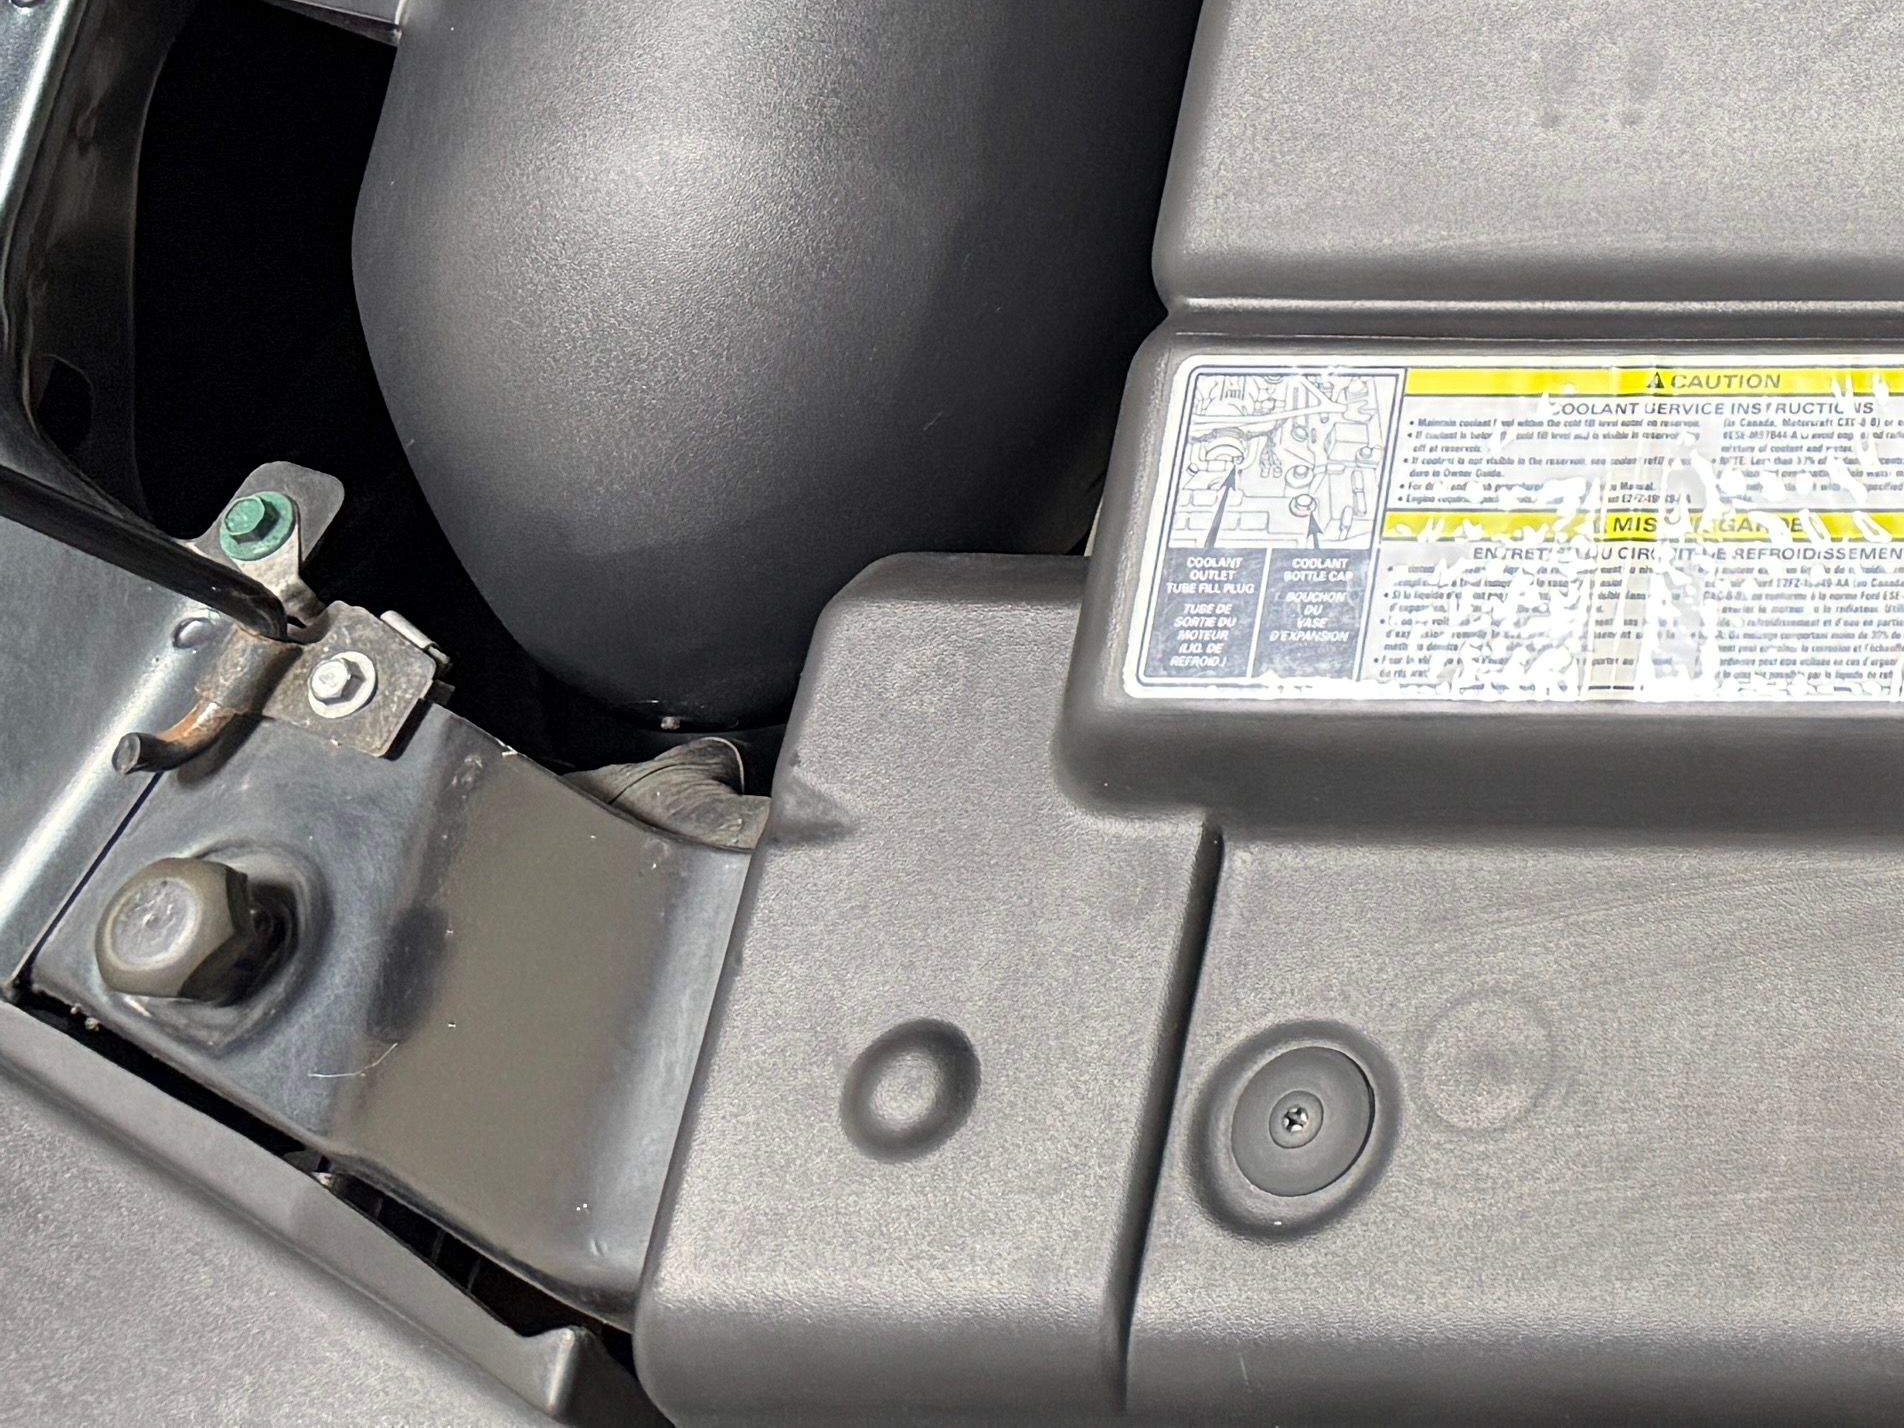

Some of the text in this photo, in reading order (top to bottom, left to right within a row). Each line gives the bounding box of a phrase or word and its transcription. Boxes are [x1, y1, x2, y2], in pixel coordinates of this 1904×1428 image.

[1670, 373, 1781, 389] CAUTION
[1186, 556, 1244, 568] COOLANT
[1291, 557, 1350, 569] COOLANT
[1189, 568, 1236, 581] OUTLET
[1283, 570, 1354, 582] BOTTLE CAP
[1165, 582, 1255, 595] TUBE PLUG
